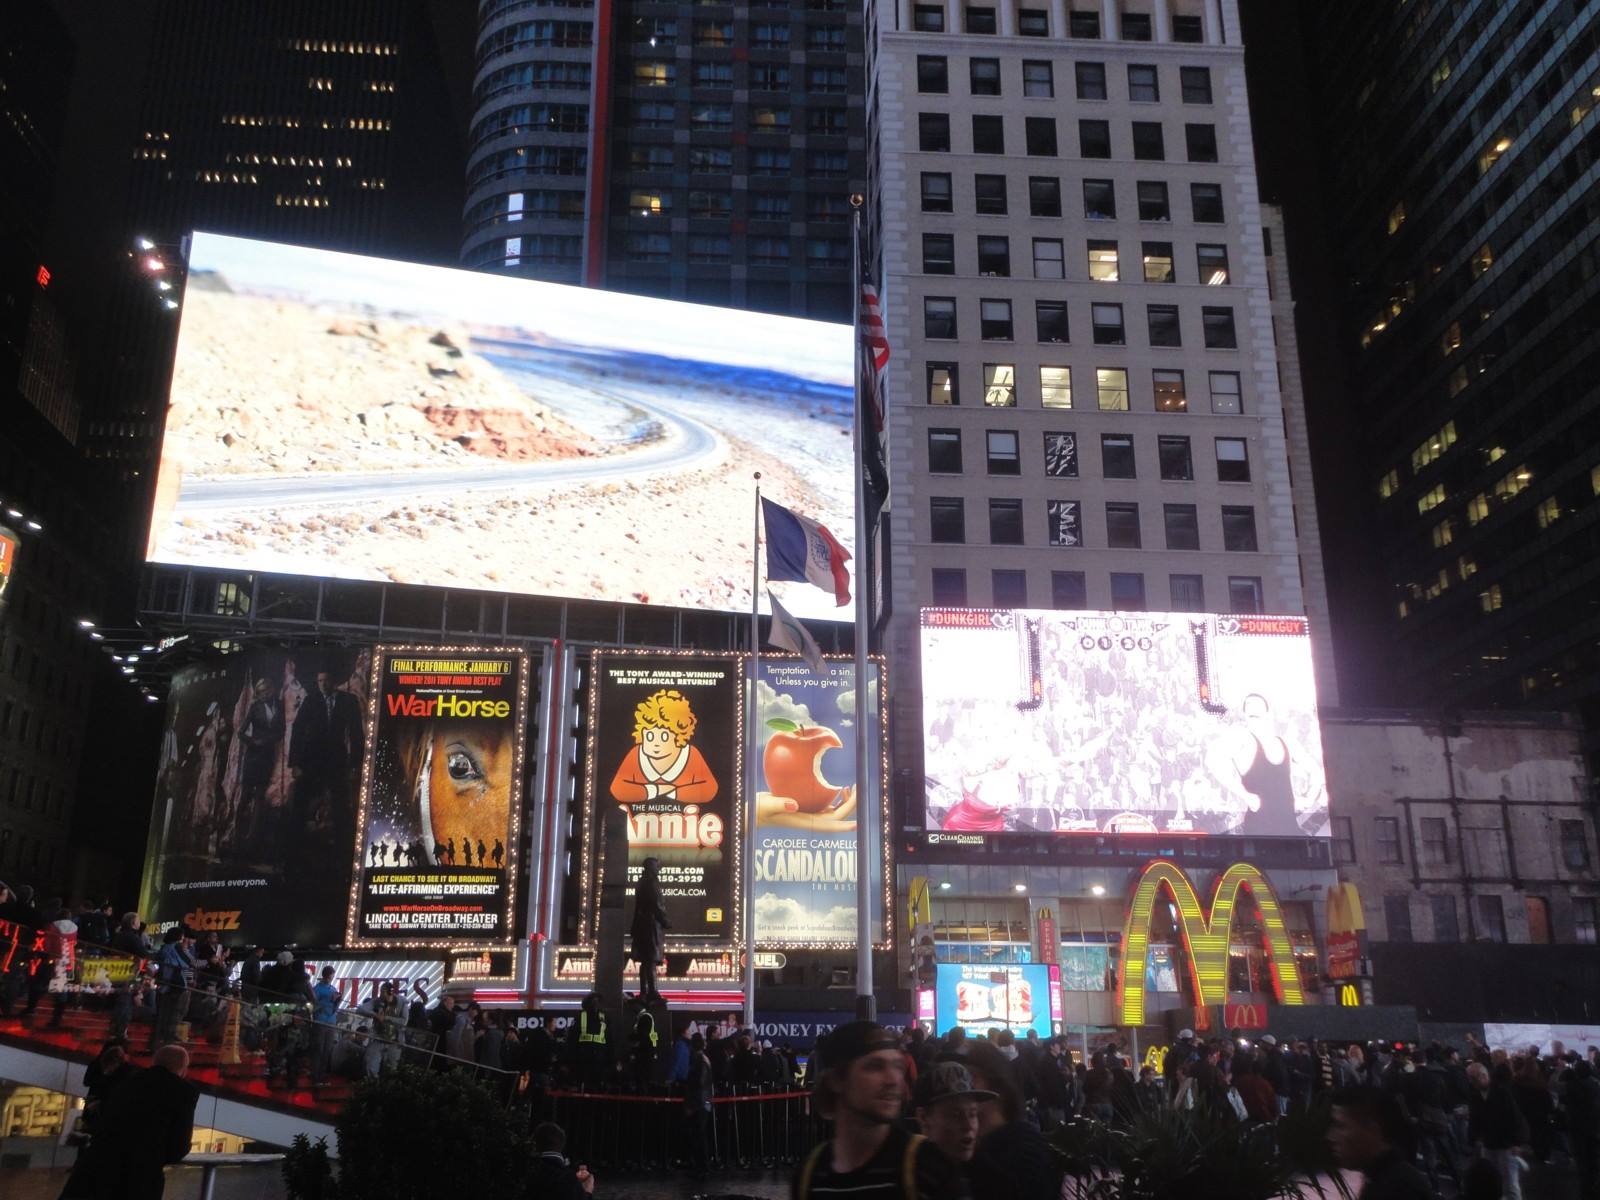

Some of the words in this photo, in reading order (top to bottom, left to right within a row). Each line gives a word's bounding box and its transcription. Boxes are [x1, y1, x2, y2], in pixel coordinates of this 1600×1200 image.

[928, 612, 992, 626] #DUNKGIRL
[1241, 620, 1301, 633] #DUNKGUY
[393, 660, 414, 672] FINAL
[415, 661, 468, 673] PERFORMANCE
[469, 661, 502, 673] JANUARY
[502, 662, 510, 673] 6
[766, 665, 810, 677] Temptation
[652, 670, 725, 679] AWARD-WINNING
[473, 676, 488, 686] BEST
[617, 677, 636, 685] BEST
[677, 678, 717, 686] RETURNS!
[775, 676, 801, 686] Unless
[803, 679, 819, 688] you
[820, 678, 838, 688] give
[648, 804, 682, 812] MUSICAL
[762, 838, 807, 849] CAROLEE
[754, 849, 857, 882] SCANDALOU
[189, 880, 225, 888] consumes
[227, 879, 268, 887] everyone.
[373, 875, 389, 883] LAST
[390, 875, 416, 883] CHANCE
[417, 875, 425, 883] TO
[426, 875, 440, 883] SEE
[441, 875, 447, 883] IT
[448, 875, 458, 883] ON
[459, 875, 497, 883] BROADWAY!
[379, 884, 443, 895] LIFE-AFFIRMING
[184, 907, 242, 931] starz
[365, 913, 410, 924] LINCOLN
[411, 914, 451, 923] CENTER
[454, 914, 498, 924] THEATER
[453, 957, 491, 974] Annie
[560, 957, 593, 974] Ann
[686, 958, 731, 974] Annie
[753, 1023, 810, 1037] MONEY
